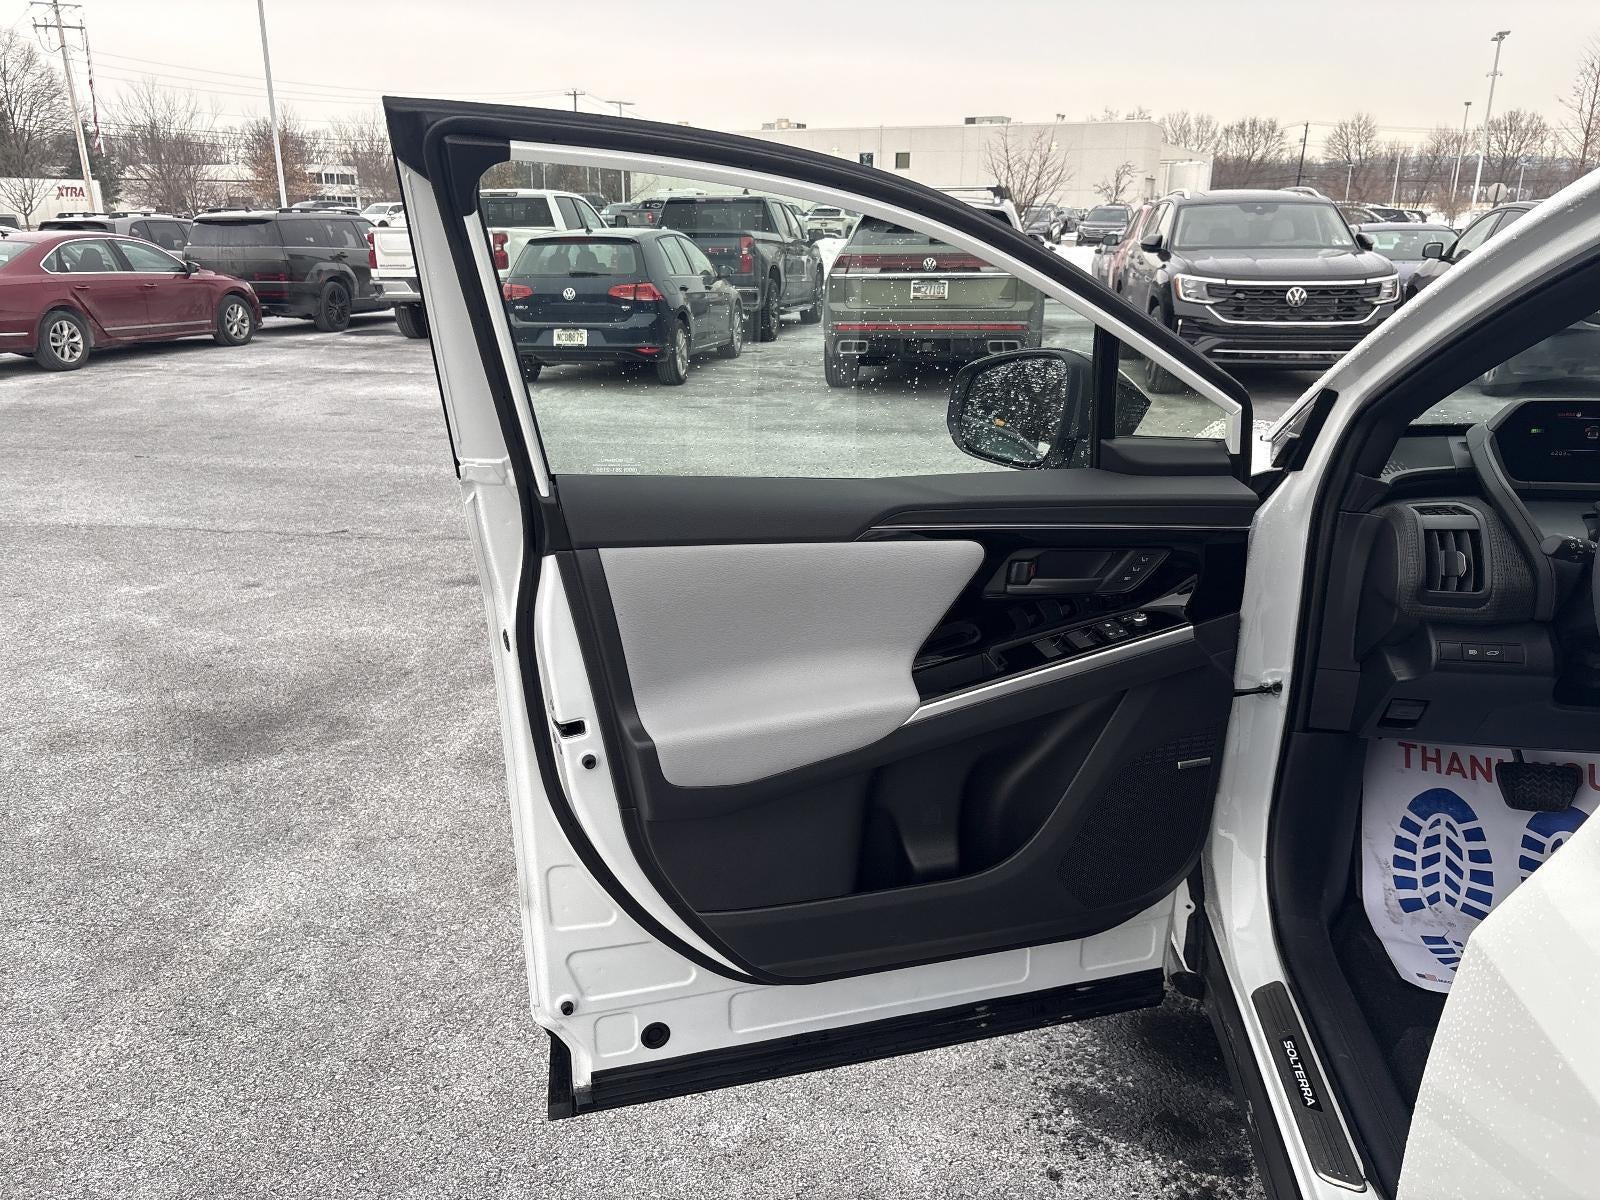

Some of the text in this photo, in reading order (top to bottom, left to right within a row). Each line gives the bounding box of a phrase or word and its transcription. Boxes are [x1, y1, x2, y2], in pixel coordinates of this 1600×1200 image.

[56, 185, 86, 200] XTRA
[1398, 741, 1504, 784] THAN
[1283, 1040, 1316, 1106] SOLTERRA
